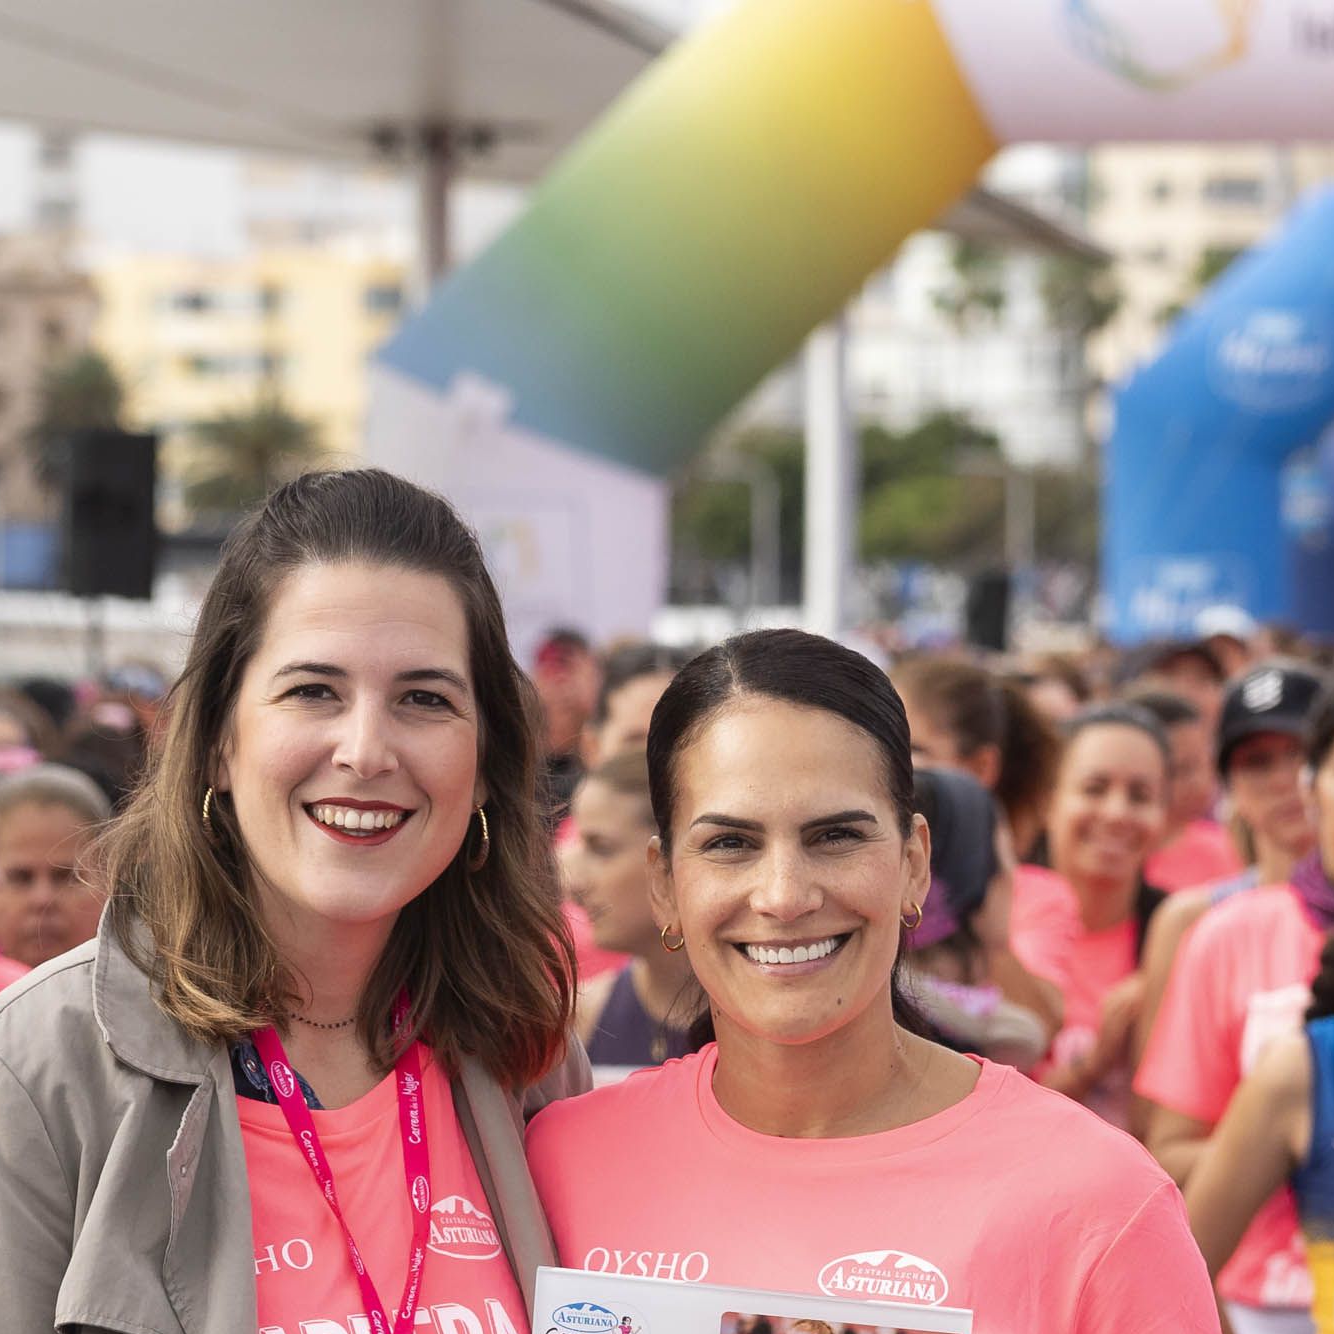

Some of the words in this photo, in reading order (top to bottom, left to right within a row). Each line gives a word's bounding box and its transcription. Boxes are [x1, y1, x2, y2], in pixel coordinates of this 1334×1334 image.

[430, 1220, 500, 1246] ASTURIANA
[583, 1246, 710, 1283] OYSHO
[850, 1266, 893, 1278] CENTRAL
[826, 1265, 937, 1301] ASTURIANA
[557, 1311, 613, 1328] ASTURIANA
